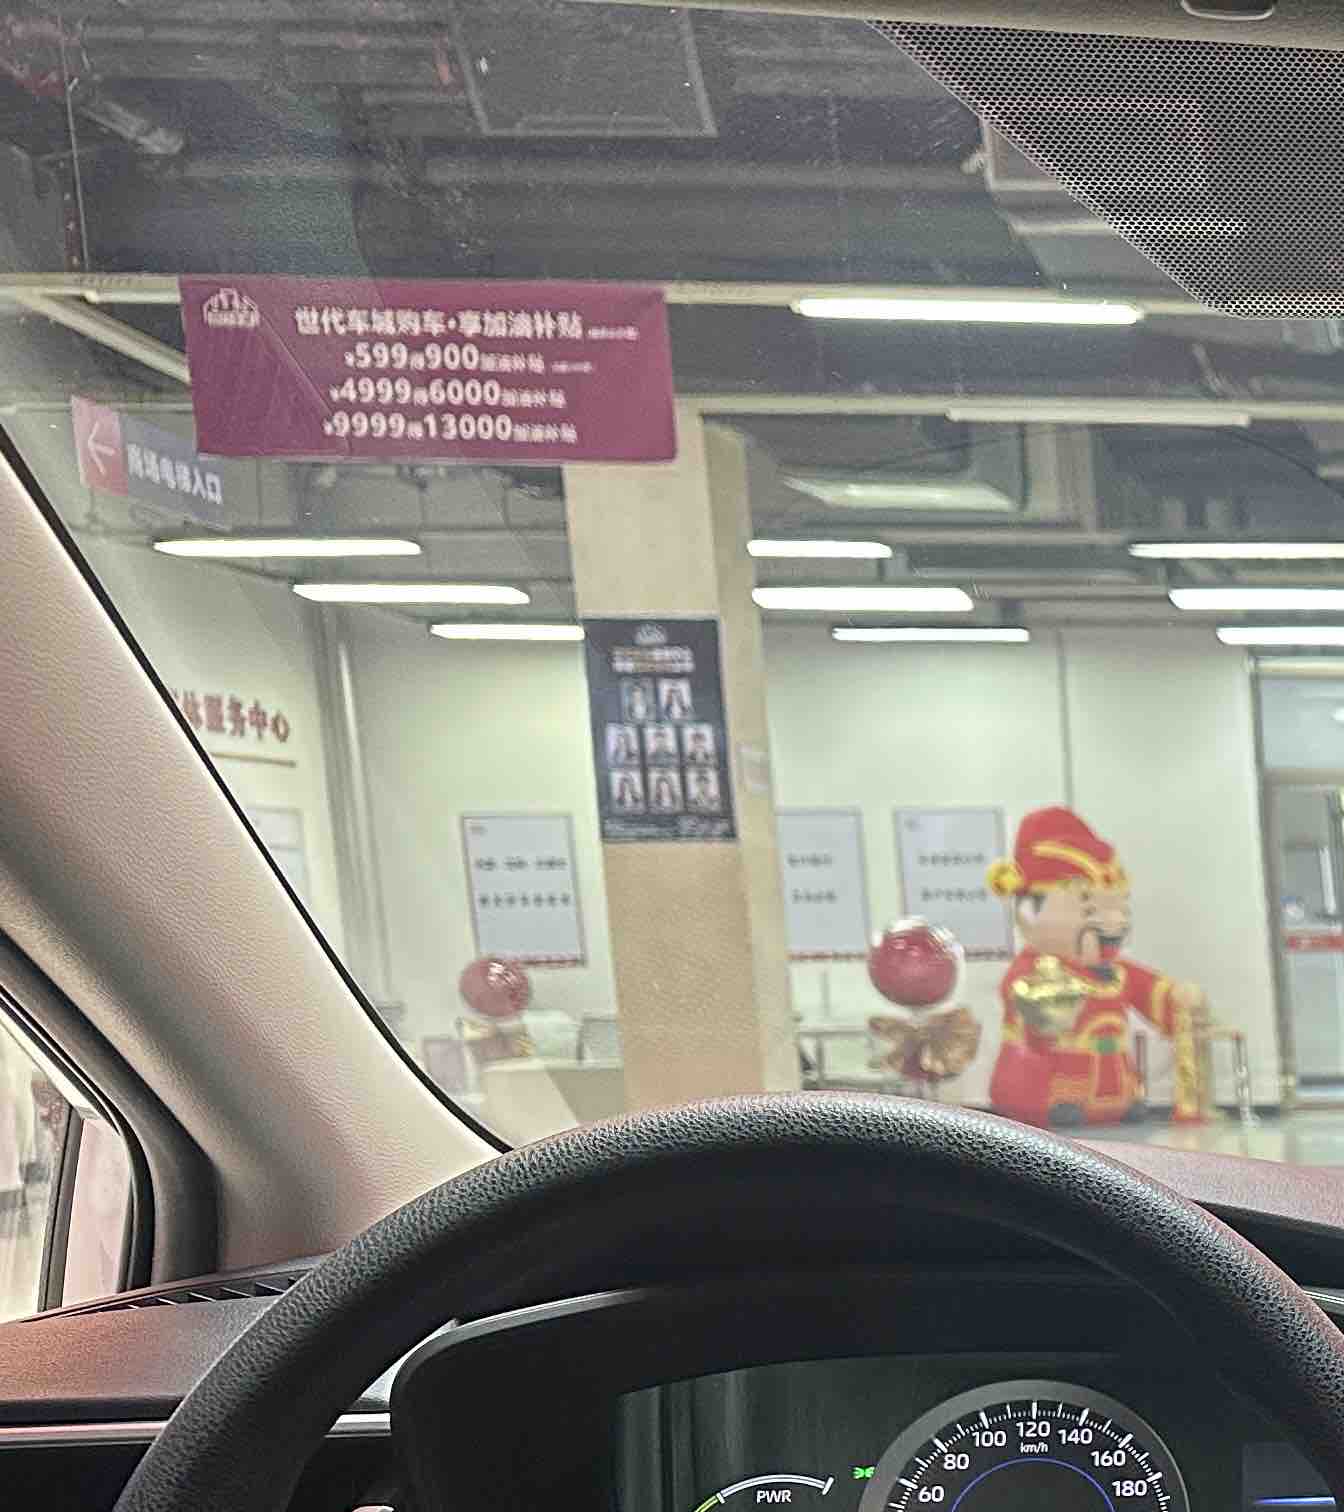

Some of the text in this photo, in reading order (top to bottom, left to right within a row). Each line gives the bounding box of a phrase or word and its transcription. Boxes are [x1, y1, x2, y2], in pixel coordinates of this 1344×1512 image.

[1015, 1420, 1050, 1438] 120
[1058, 1428, 1093, 1445] 140
[972, 1430, 1007, 1448] 100
[1019, 1441, 1049, 1454] km/h
[943, 1453, 970, 1470] 80
[1091, 1450, 1126, 1467] 160
[756, 1489, 792, 1503] PWR
[918, 1486, 945, 1502] 60
[1112, 1480, 1148, 1496] 180
